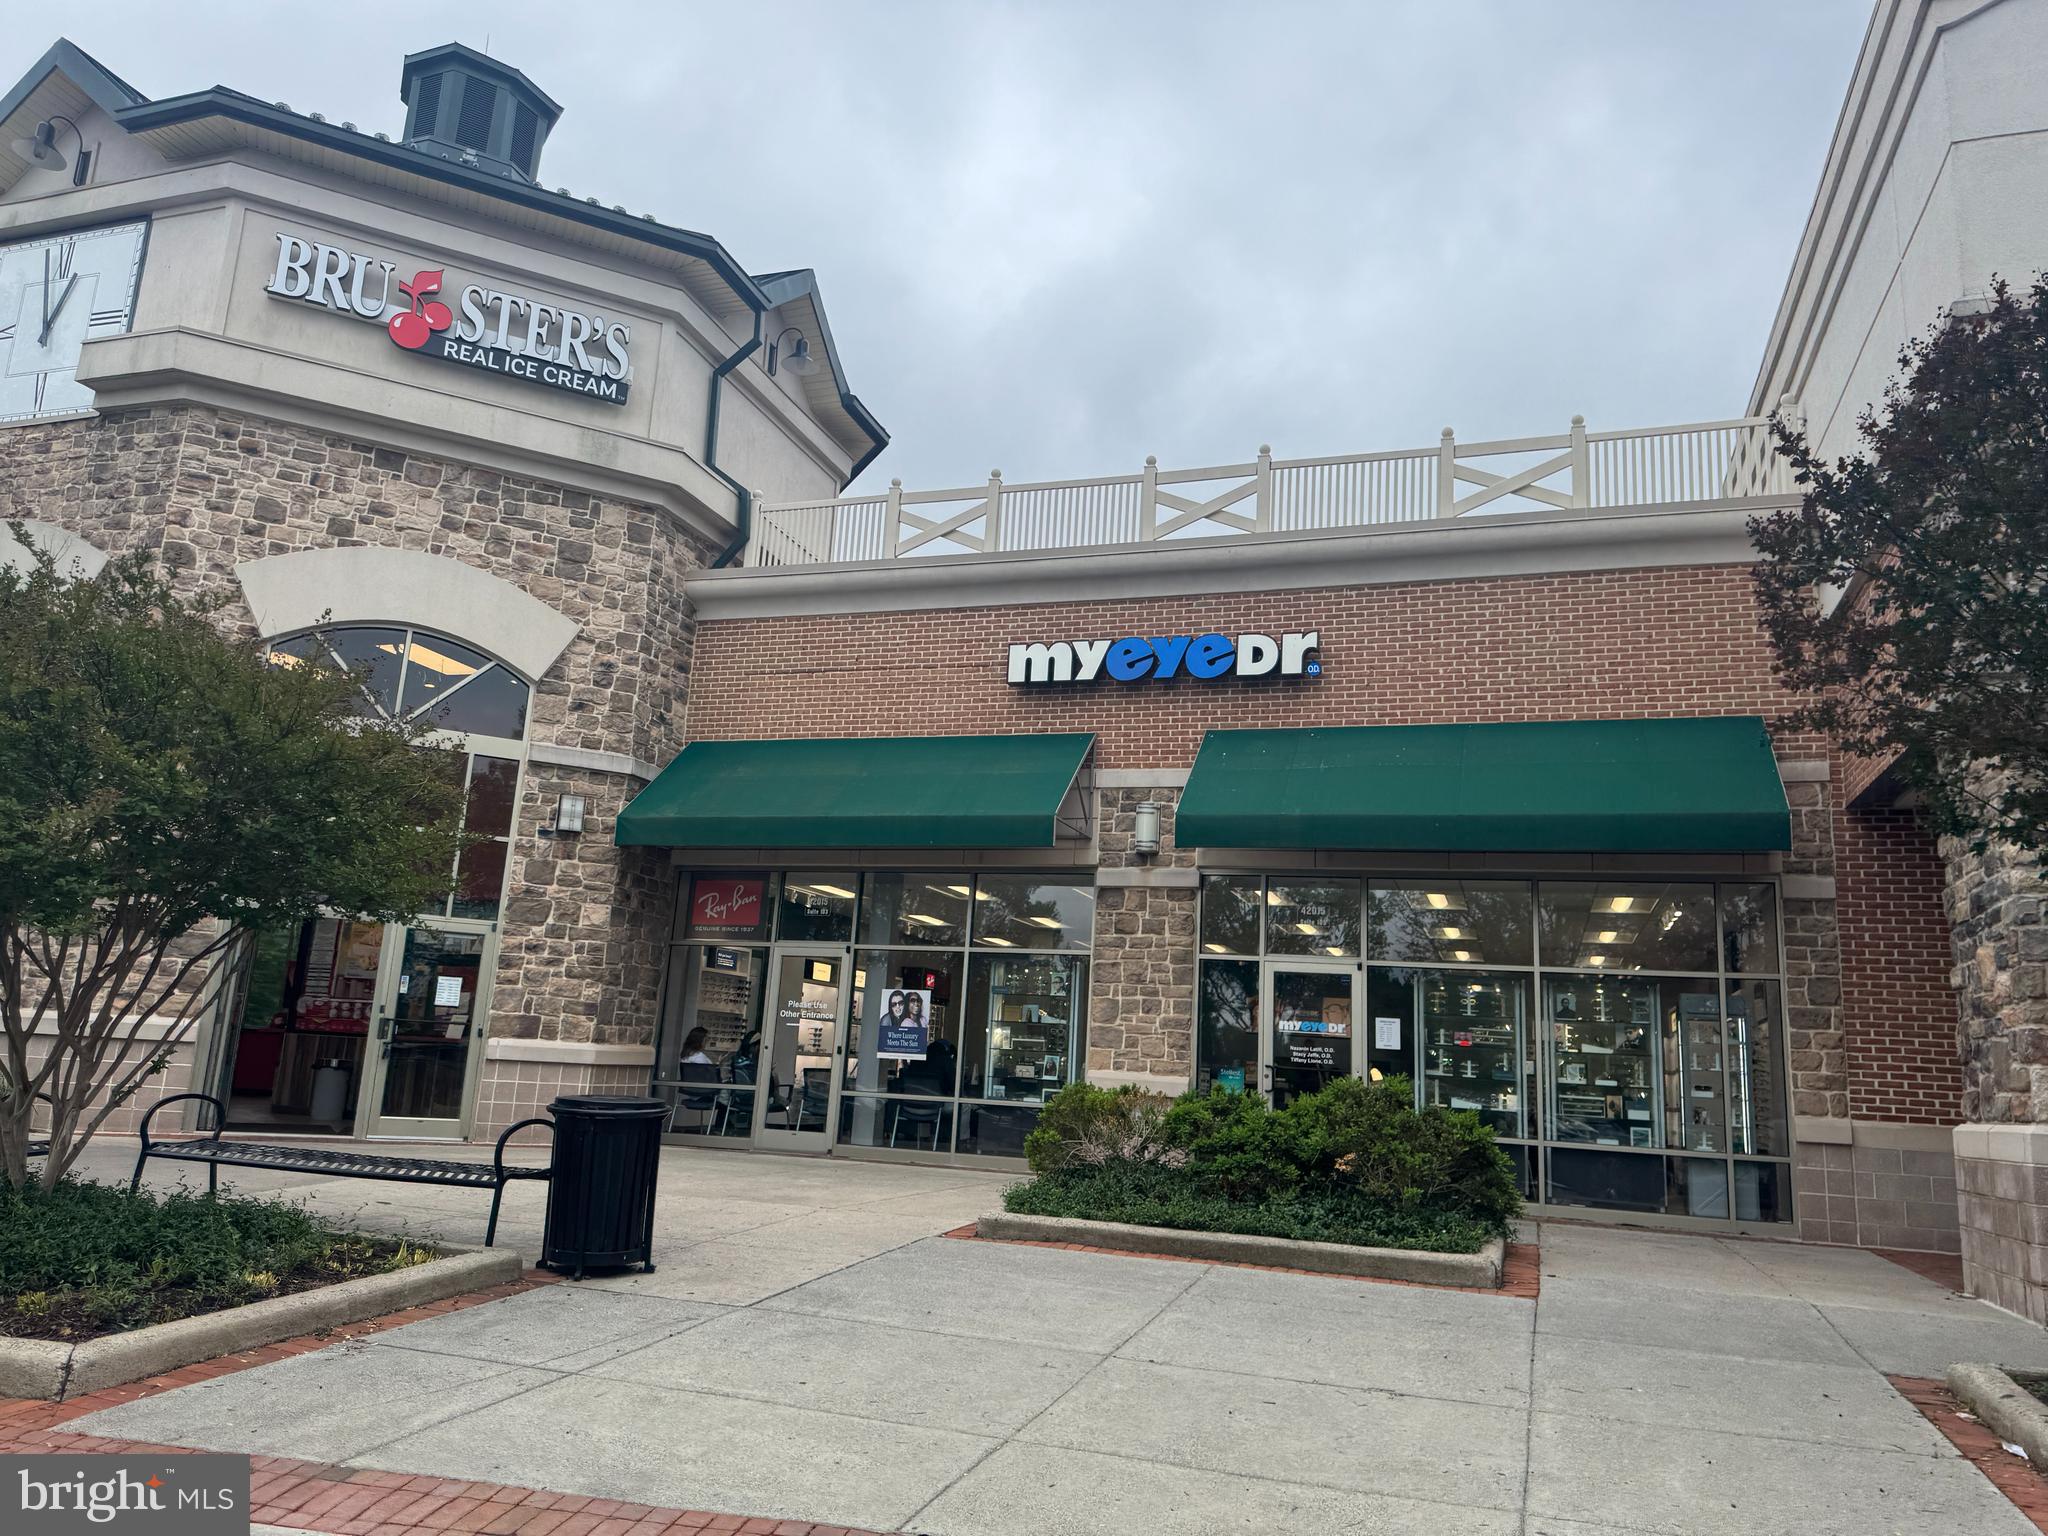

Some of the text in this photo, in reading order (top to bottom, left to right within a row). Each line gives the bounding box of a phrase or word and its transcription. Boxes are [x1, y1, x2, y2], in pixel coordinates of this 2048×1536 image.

[443, 340, 500, 370] REAL
[504, 355, 537, 379] ICE
[542, 366, 617, 399] CREAM
[698, 884, 758, 920] Ray-Ban
[788, 1000, 828, 1009] Please Use
[780, 1009, 834, 1020] Other Entrance
[887, 1031, 919, 1041] Where Luxury
